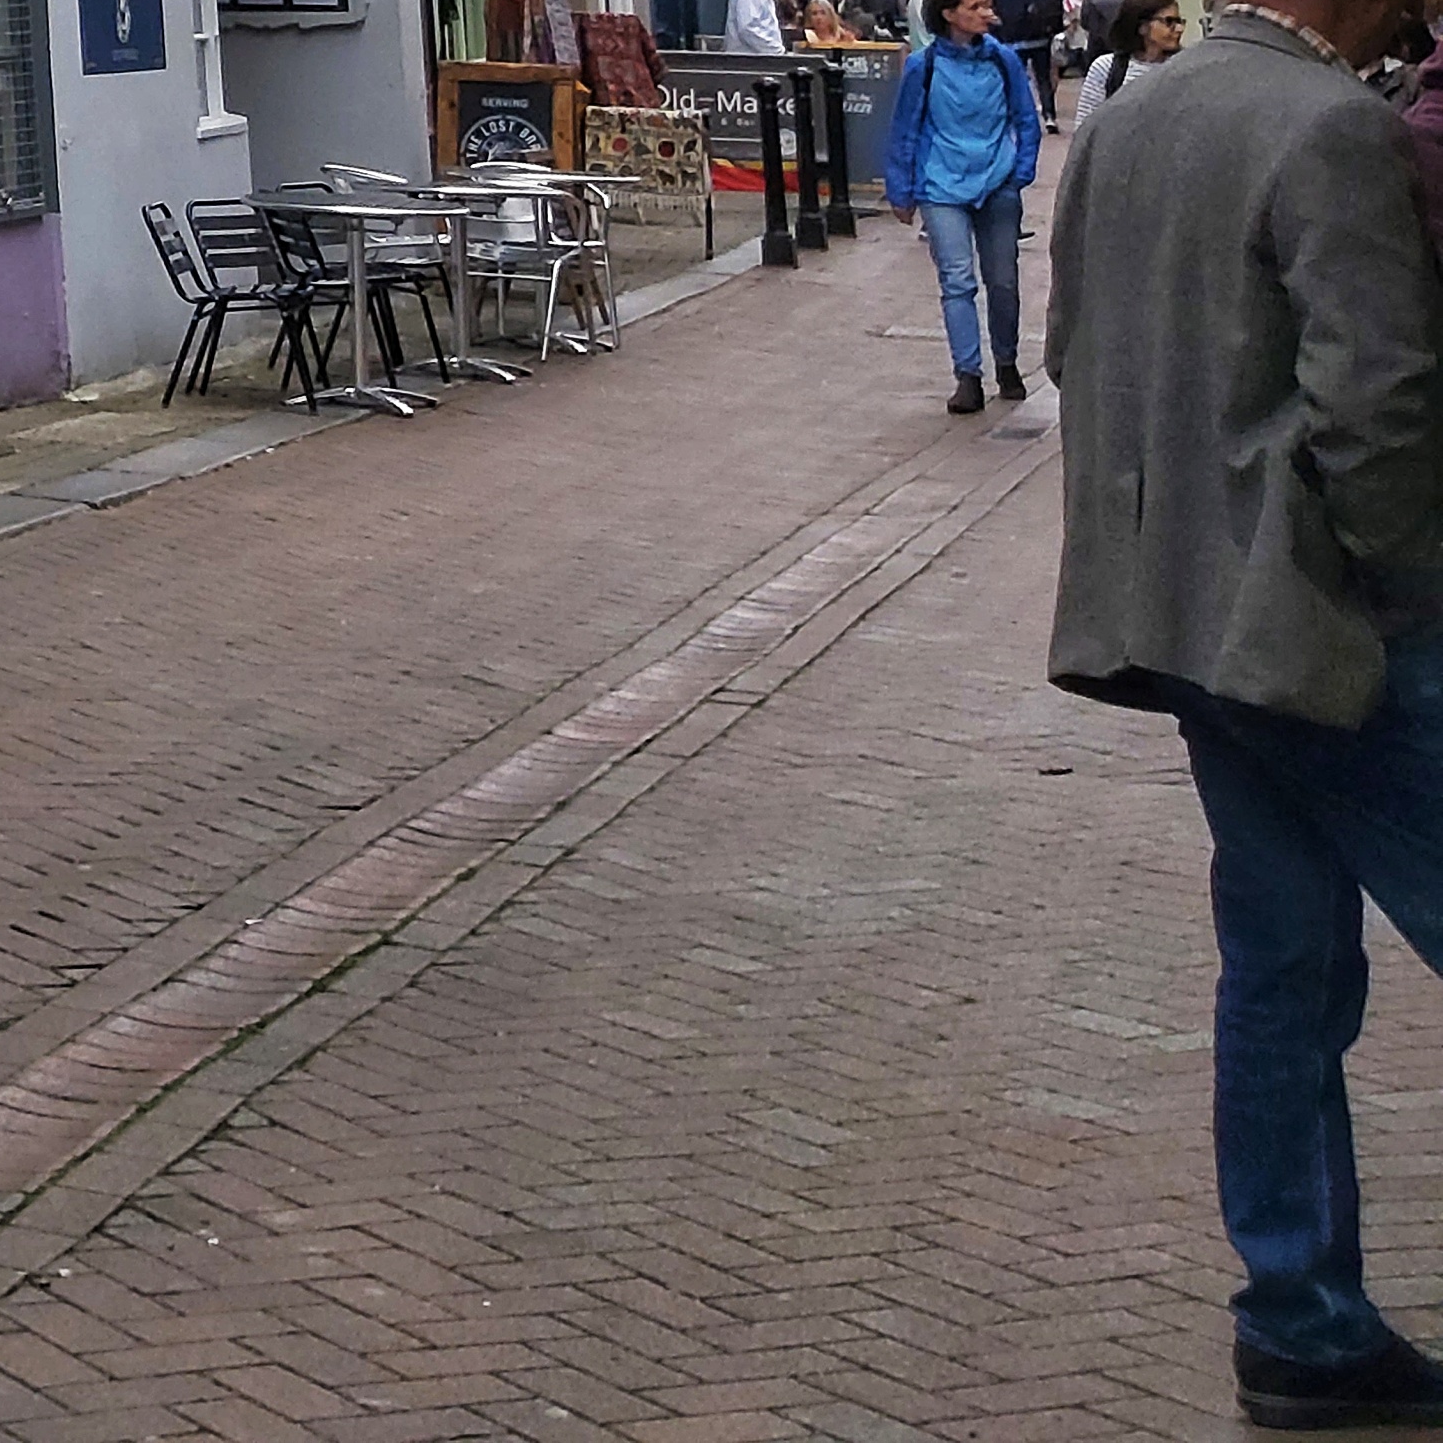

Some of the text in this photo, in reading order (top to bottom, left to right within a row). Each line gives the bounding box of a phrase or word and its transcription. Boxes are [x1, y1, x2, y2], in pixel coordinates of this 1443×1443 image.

[716, 89, 797, 116] Make
[466, 134, 483, 159] THE
[480, 119, 517, 138] LOST
